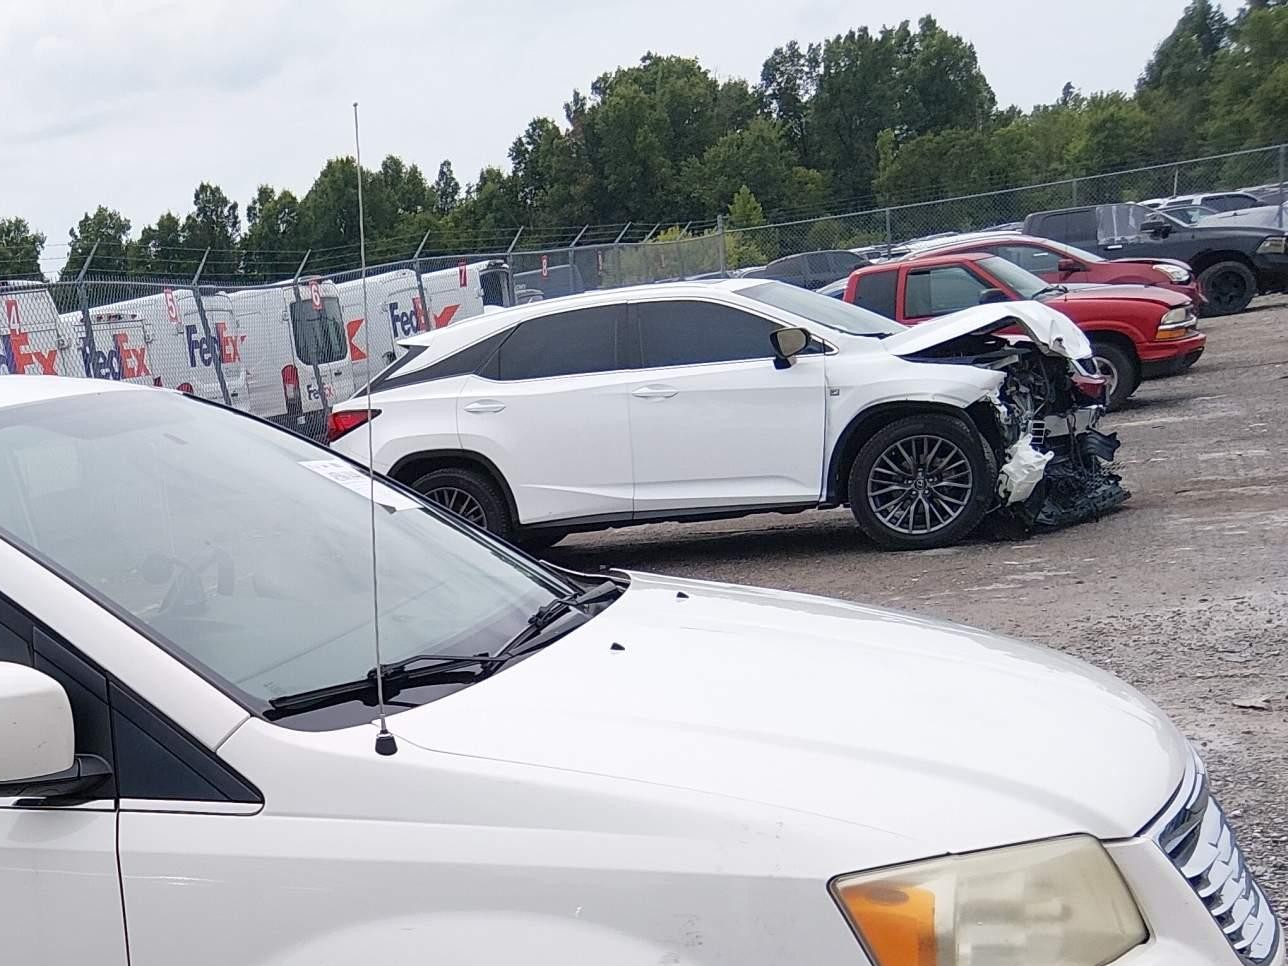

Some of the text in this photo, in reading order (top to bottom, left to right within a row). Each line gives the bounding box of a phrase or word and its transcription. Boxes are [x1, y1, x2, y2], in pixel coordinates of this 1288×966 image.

[166, 294, 176, 318] 5
[311, 281, 321, 307] 6
[10, 301, 20, 334] 4
